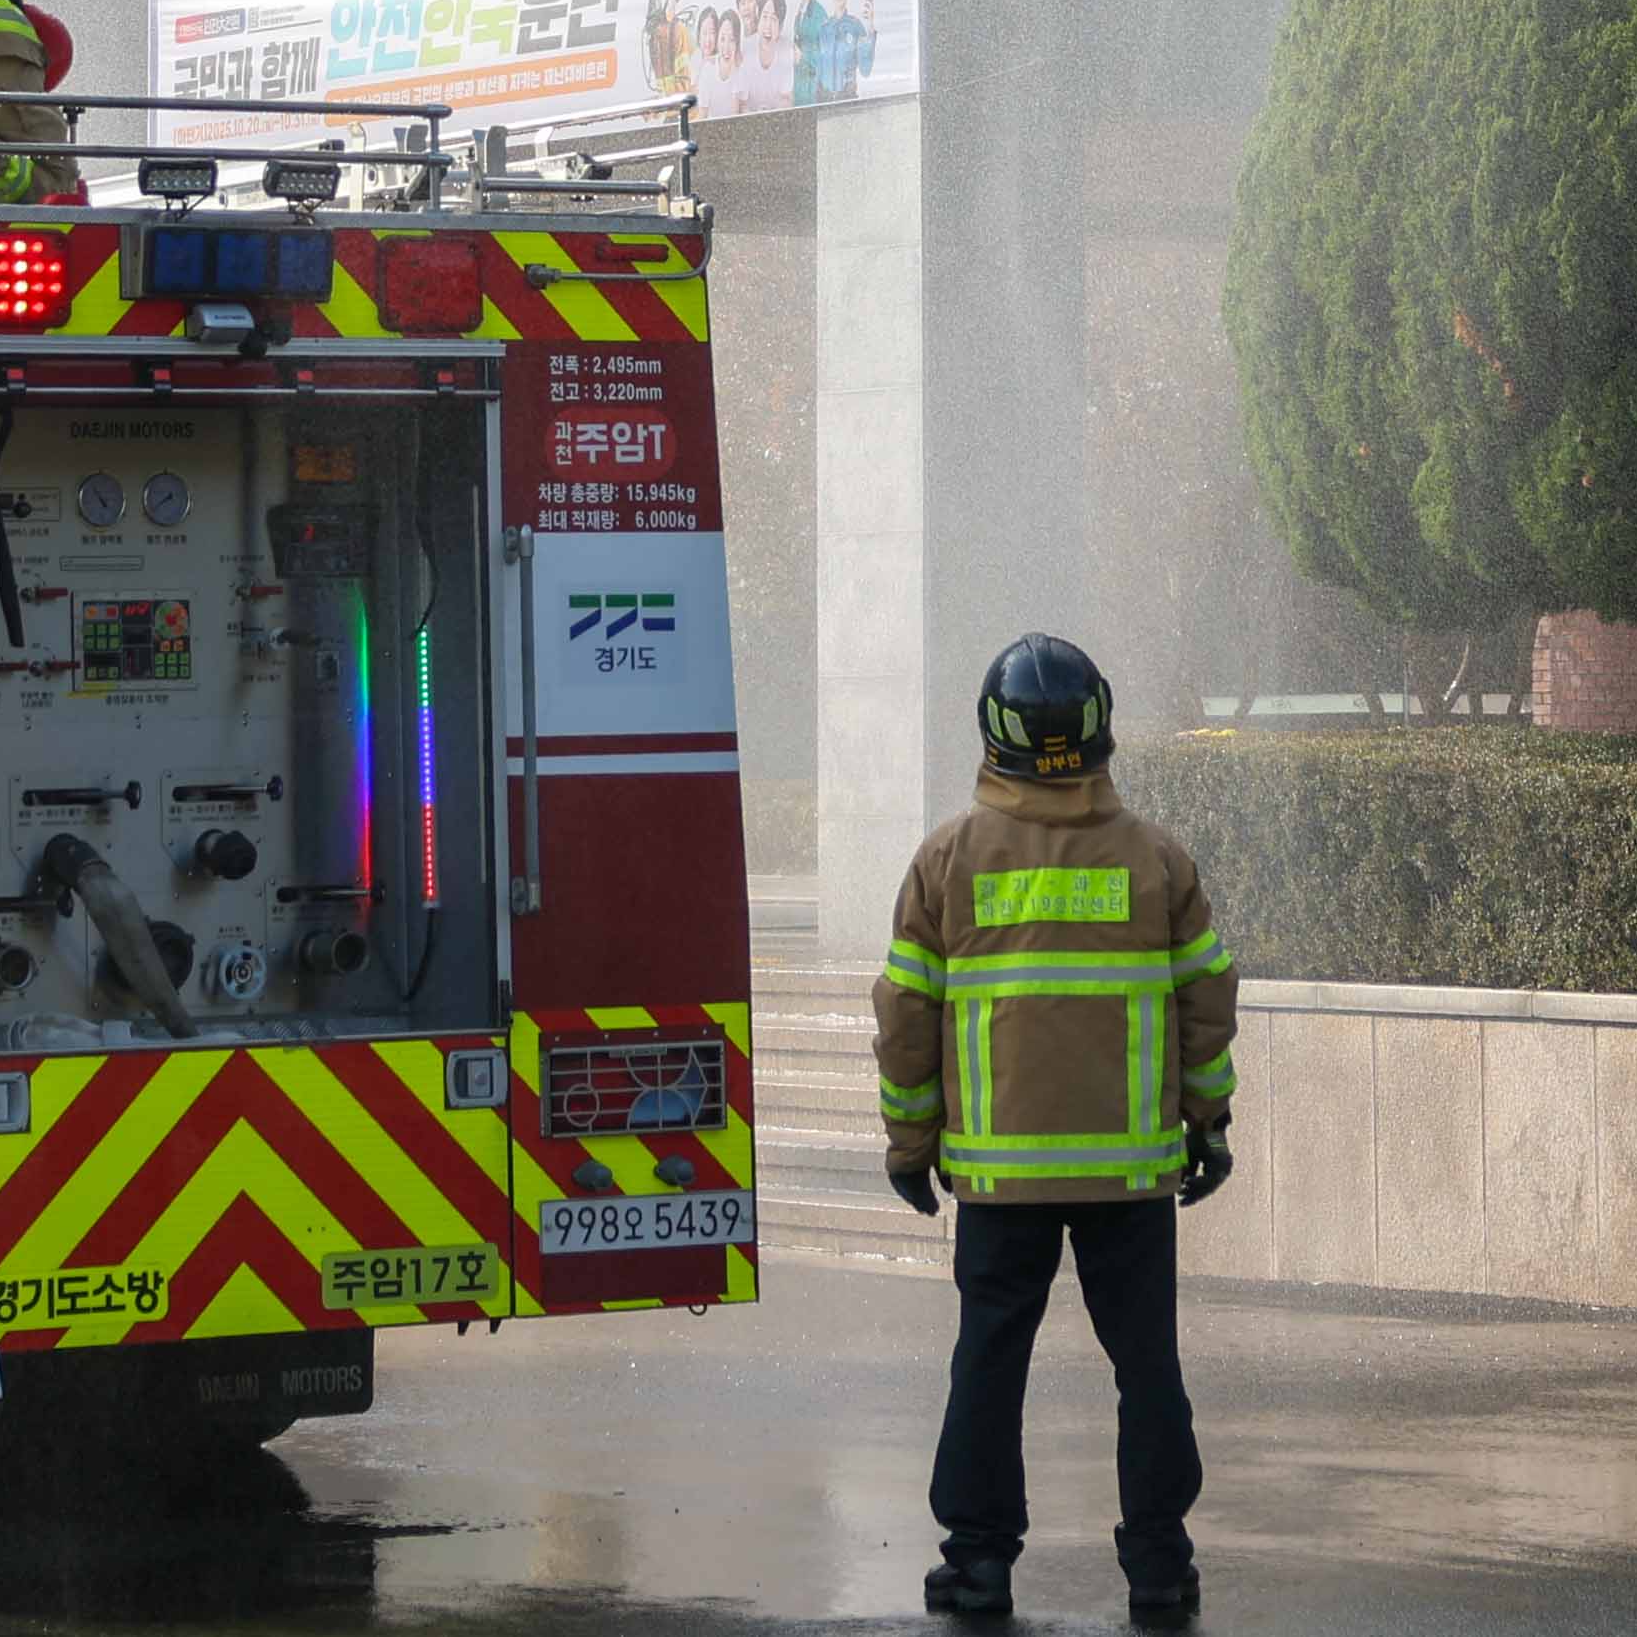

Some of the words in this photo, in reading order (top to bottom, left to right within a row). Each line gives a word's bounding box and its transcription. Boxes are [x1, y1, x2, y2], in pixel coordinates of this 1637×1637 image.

[174, 47, 252, 100] 국민과
[262, 36, 321, 99] 함께
[549, 355, 580, 375] 전폭
[592, 356, 662, 375] 2,495mm
[550, 382, 580, 402] 전고
[593, 383, 663, 402] 3,220mm
[70, 420, 125, 440] DAEJIN
[129, 420, 195, 439] MOTORS
[575, 421, 666, 464] 주암T
[538, 482, 566, 503] 차량
[626, 484, 696, 503] 15,945kg
[538, 510, 567, 530] 최대
[634, 510, 697, 531] 6,000kg
[594, 646, 657, 673] 경기도
[554, 1205, 644, 1246] 998오
[655, 1198, 740, 1240] 5439
[332, 1251, 490, 1301] 주암17호
[281, 1365, 363, 1396] MOTORS
